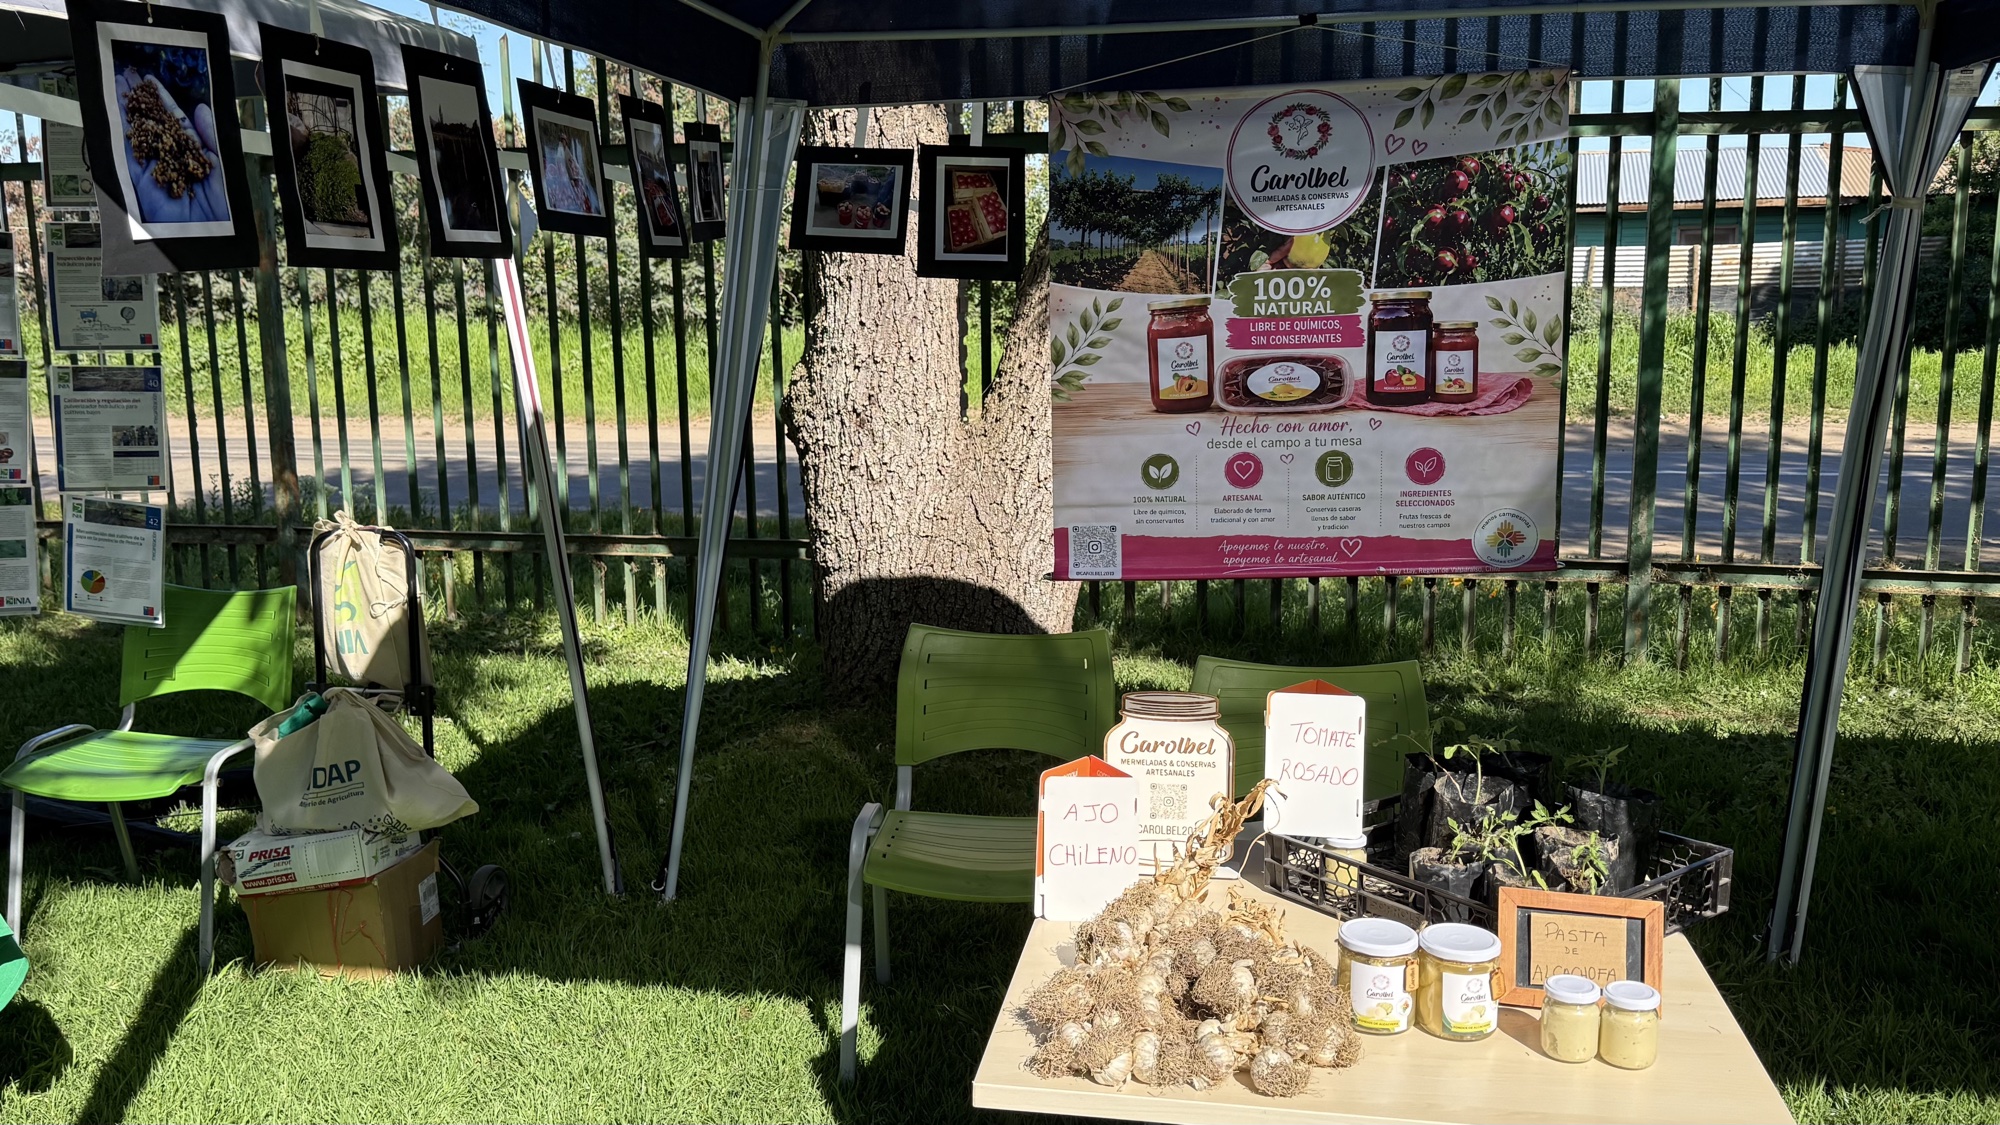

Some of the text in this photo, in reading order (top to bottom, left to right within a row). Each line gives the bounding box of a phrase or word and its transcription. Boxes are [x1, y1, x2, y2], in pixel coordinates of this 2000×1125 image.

[1250, 164, 1349, 193] Carolbel
[1252, 194, 1300, 203] MERMELADAS
[1308, 192, 1349, 200] CONSERVAS
[1275, 202, 1325, 212] ARTESANALES
[1254, 276, 1331, 300] 100%
[1254, 300, 1335, 316] NATURAL
[1250, 318, 1342, 332] LIBRE DE QUÍMICOS,
[1251, 334, 1342, 346] SIN CONSERVANTES
[1387, 352, 1415, 361] Carolbel
[1171, 359, 1199, 370] Carolbel
[147, 380, 159, 388] 40
[1220, 416, 1353, 437] Hecho con amor,
[1206, 437, 1362, 450] desde el campo a tu mesa
[1133, 495, 1186, 504] 100% NATURAL
[1222, 494, 1263, 502] ARTESANAL
[1328, 492, 1366, 500] AUTÉNTICO
[1400, 490, 1452, 498] INGREDIENTES
[1396, 500, 1456, 508] SELECCIONADOS
[148, 518, 159, 526] 42
[1481, 512, 1532, 530] manos campesinas
[1218, 540, 1270, 555] Apoyemos
[1274, 539, 1284, 550] lo
[1223, 552, 1338, 567] apoyemos lo artesanal
[14, 597, 32, 605] INIA
[1290, 722, 1356, 748] TOMATE
[1120, 730, 1216, 756] Carolbel
[1120, 758, 1168, 766] MERMELADAS
[1176, 760, 1216, 768] CONSERVAS
[1146, 768, 1195, 777] ARTESANALES
[1279, 758, 1359, 786] ROSADO
[327, 790, 364, 805] Agricultura
[1063, 802, 1118, 824] AJO
[248, 845, 292, 862] PRISA
[273, 860, 292, 868] DEPOT
[244, 873, 295, 888] www.prisa.cl
[1544, 922, 1608, 947] PASTA
[1564, 946, 1580, 956] DE
[1366, 988, 1394, 998] Carolbel
